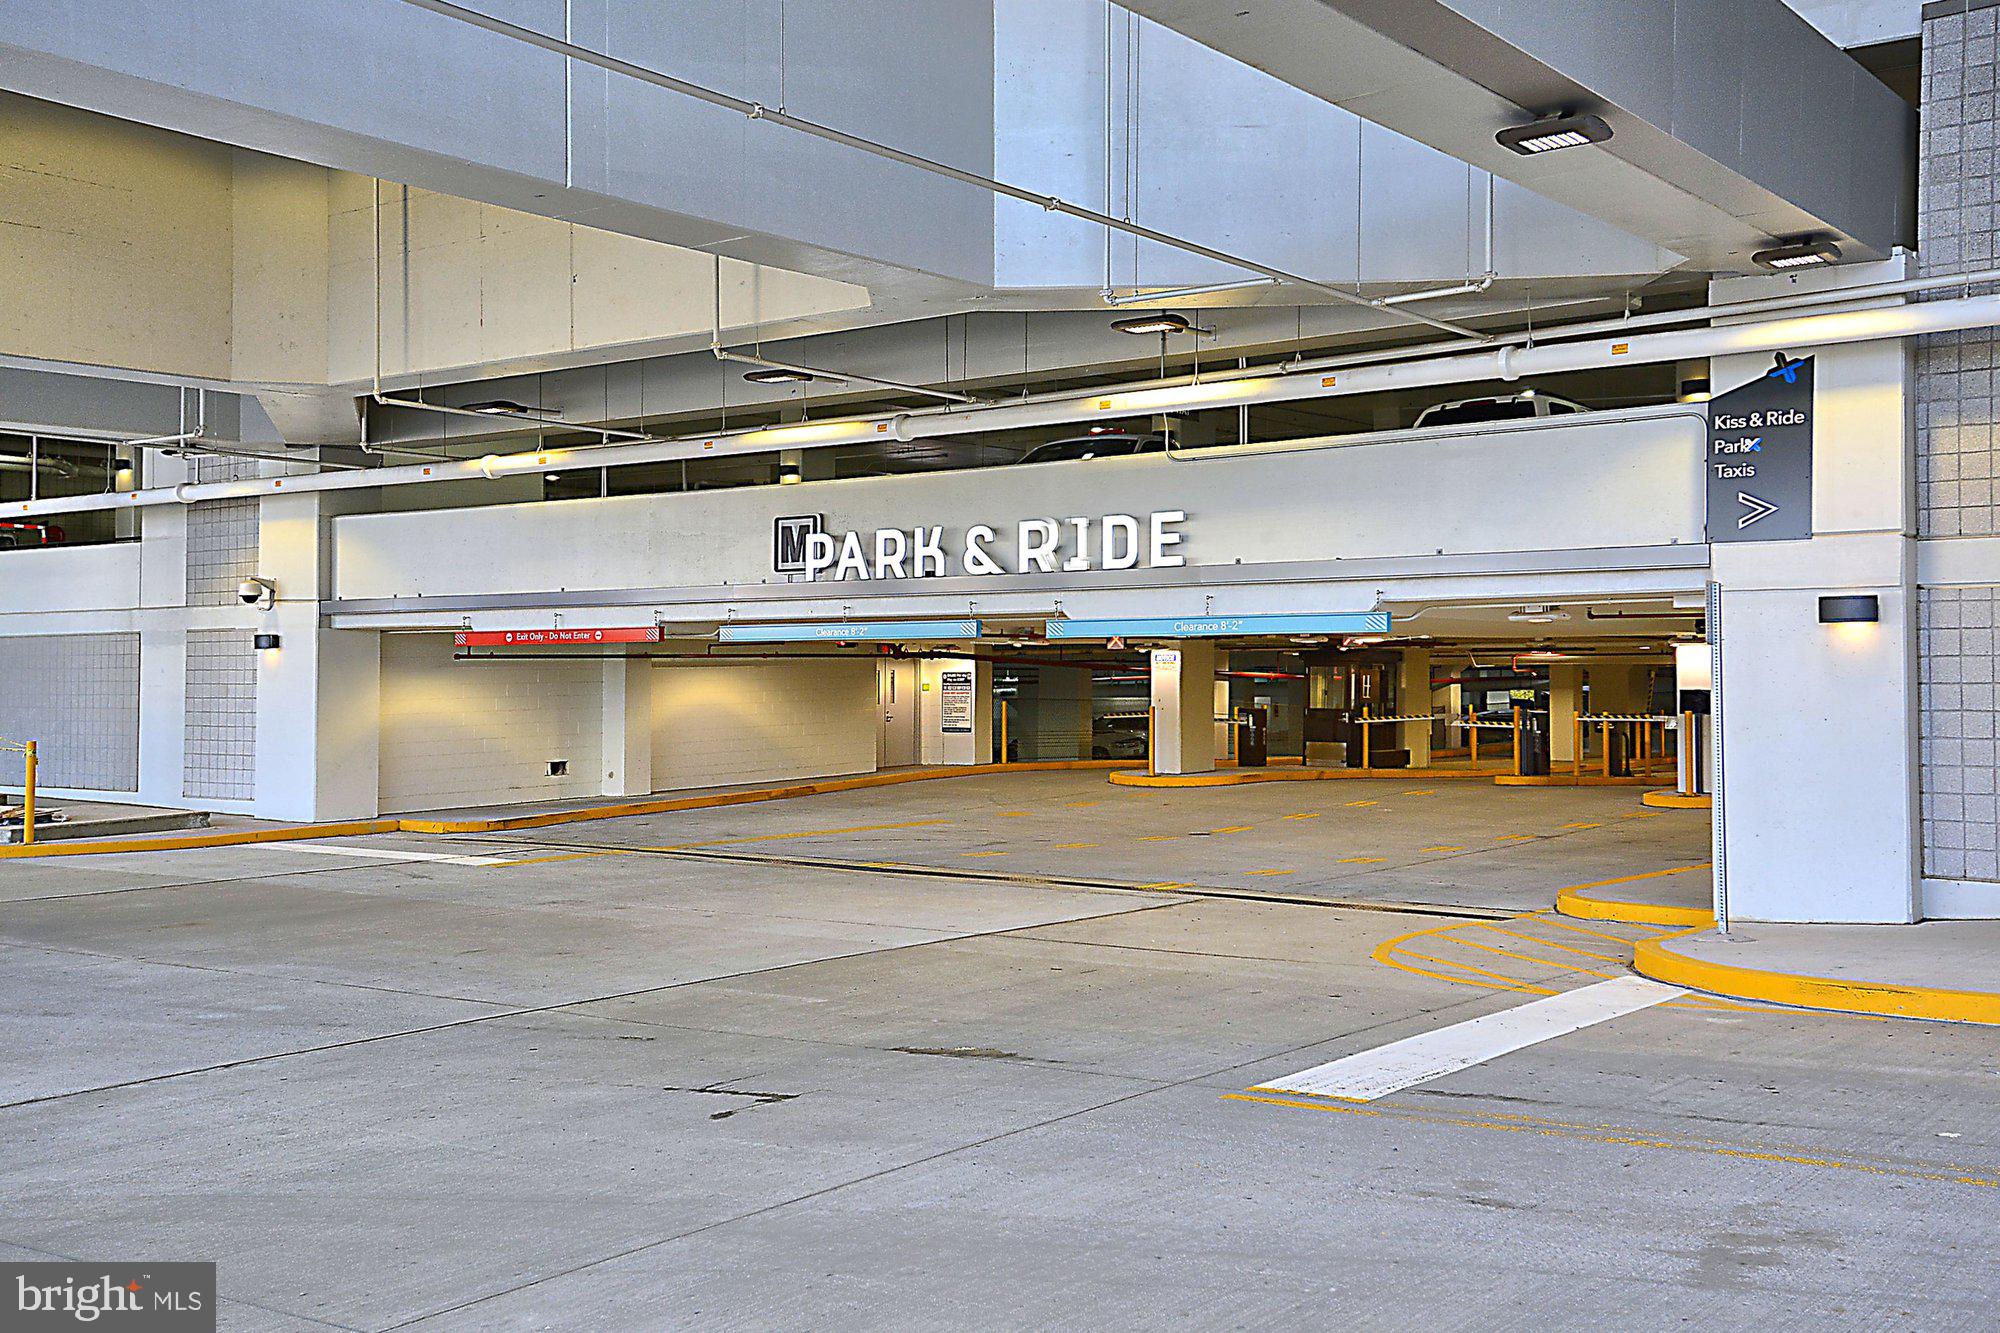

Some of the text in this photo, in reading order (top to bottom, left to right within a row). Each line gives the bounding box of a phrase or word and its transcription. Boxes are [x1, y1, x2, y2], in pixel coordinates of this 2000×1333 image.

[1714, 409, 1805, 430] Kiss & Ride
[1714, 463, 1755, 478] Taxis
[805, 526, 946, 582] PARK
[963, 525, 1006, 575] &
[1018, 510, 1187, 573] RIDE
[815, 628, 849, 637] Clearance
[1173, 622, 1218, 632] Clearance
[516, 632, 529, 641] Exit
[530, 632, 544, 643] Only
[549, 632, 558, 640] Do
[559, 631, 572, 640] Not
[573, 631, 590, 640] Enter
